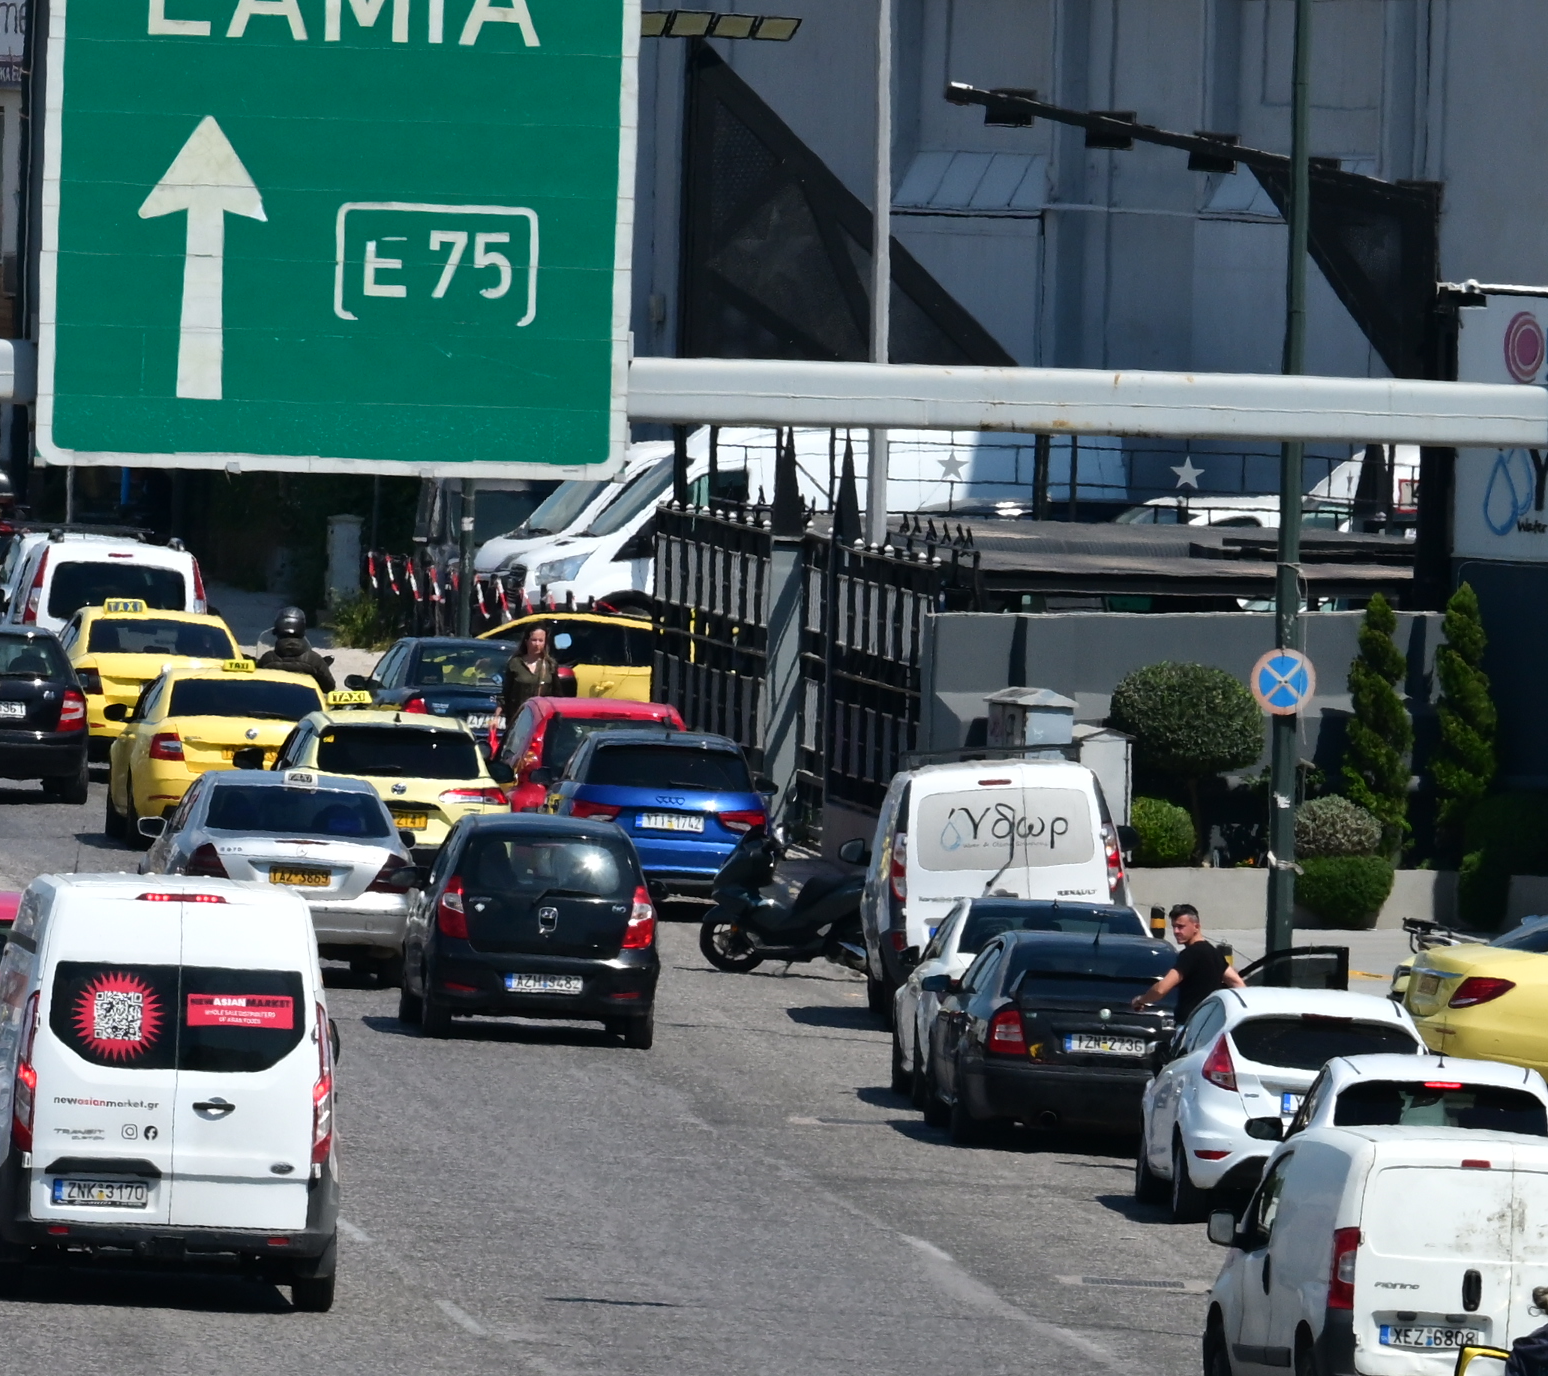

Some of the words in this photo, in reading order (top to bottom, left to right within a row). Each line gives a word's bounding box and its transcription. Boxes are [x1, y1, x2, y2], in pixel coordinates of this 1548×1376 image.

[363, 236, 408, 298] E
[429, 230, 513, 300] 75
[108, 602, 143, 612] TAXI
[228, 662, 249, 670] TAXI
[332, 692, 366, 703] TAXI
[53, 1095, 160, 1110] newasianmarket.gr
[67, 1181, 145, 1201] ZNK-3170
[1391, 1326, 1478, 1347] XEZ-6808
